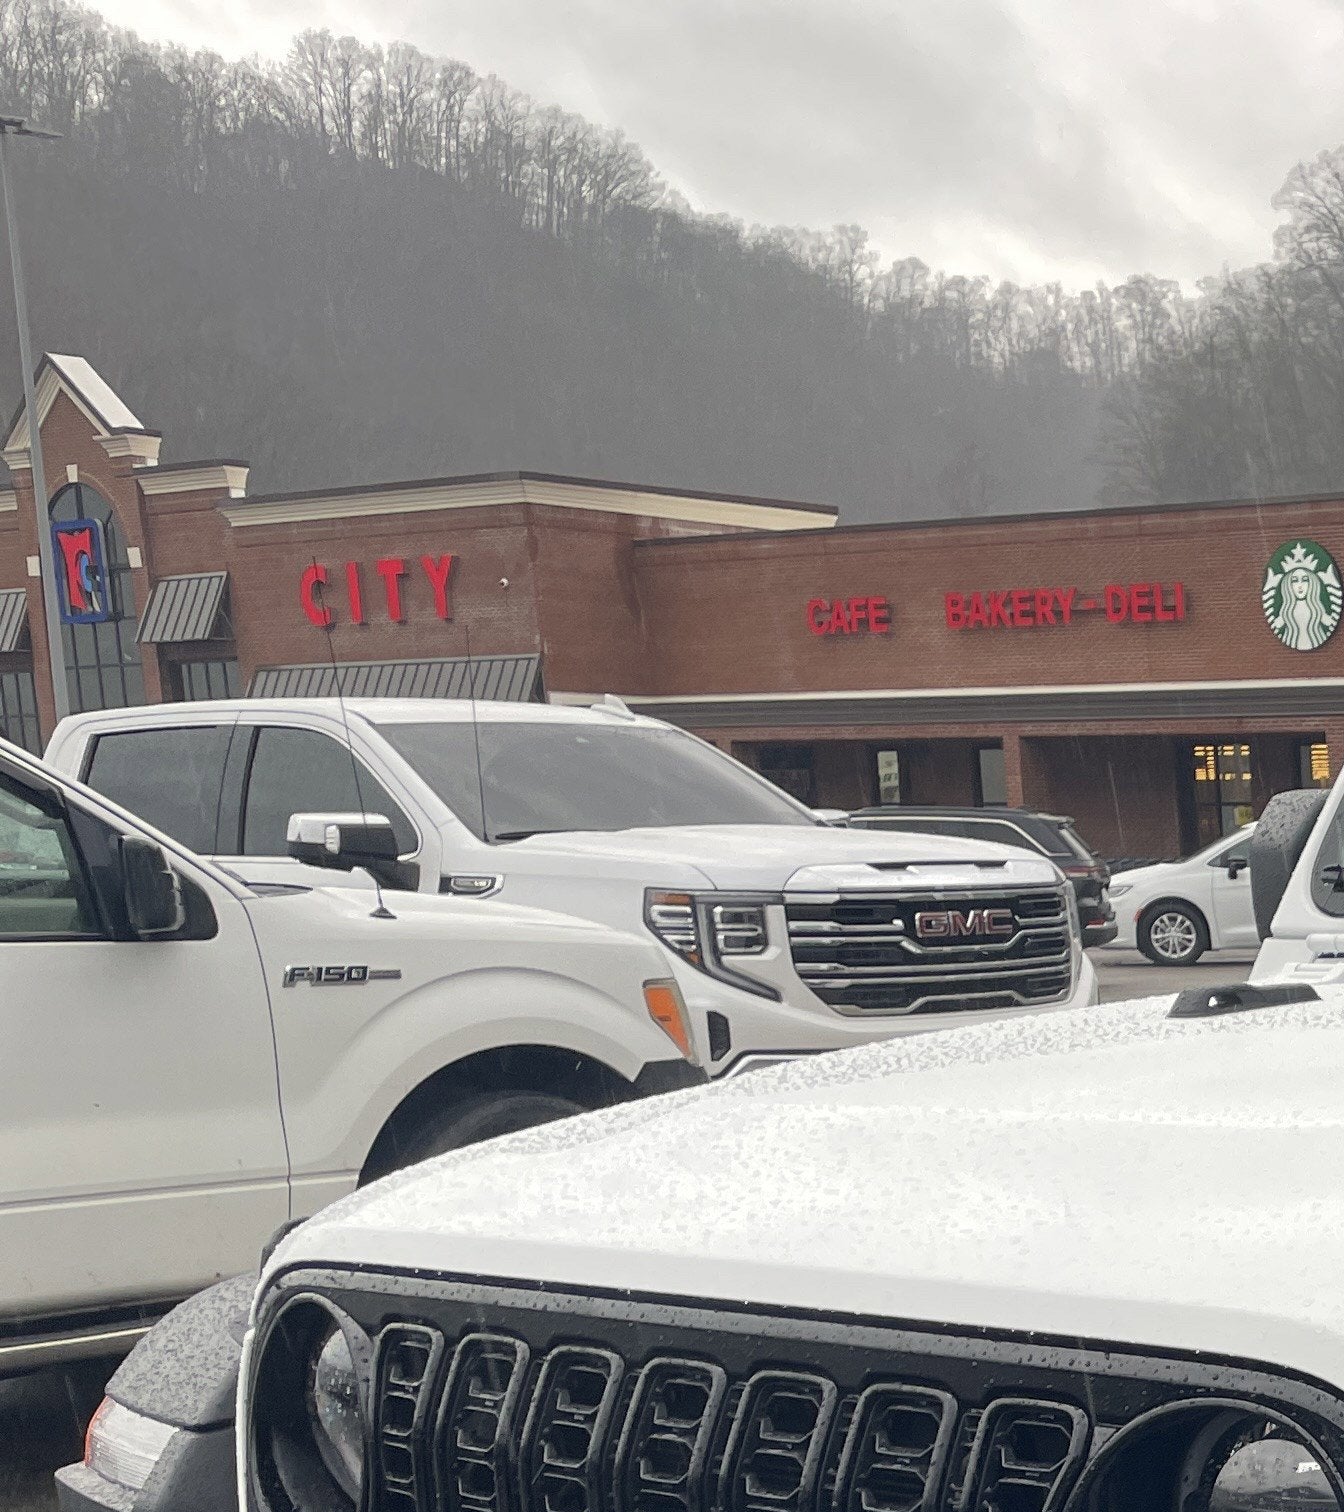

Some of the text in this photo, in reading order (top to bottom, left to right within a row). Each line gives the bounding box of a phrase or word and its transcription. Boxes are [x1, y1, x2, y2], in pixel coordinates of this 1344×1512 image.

[301, 552, 452, 628] CITY
[806, 596, 890, 636] CAFE
[915, 908, 1013, 938] GMC
